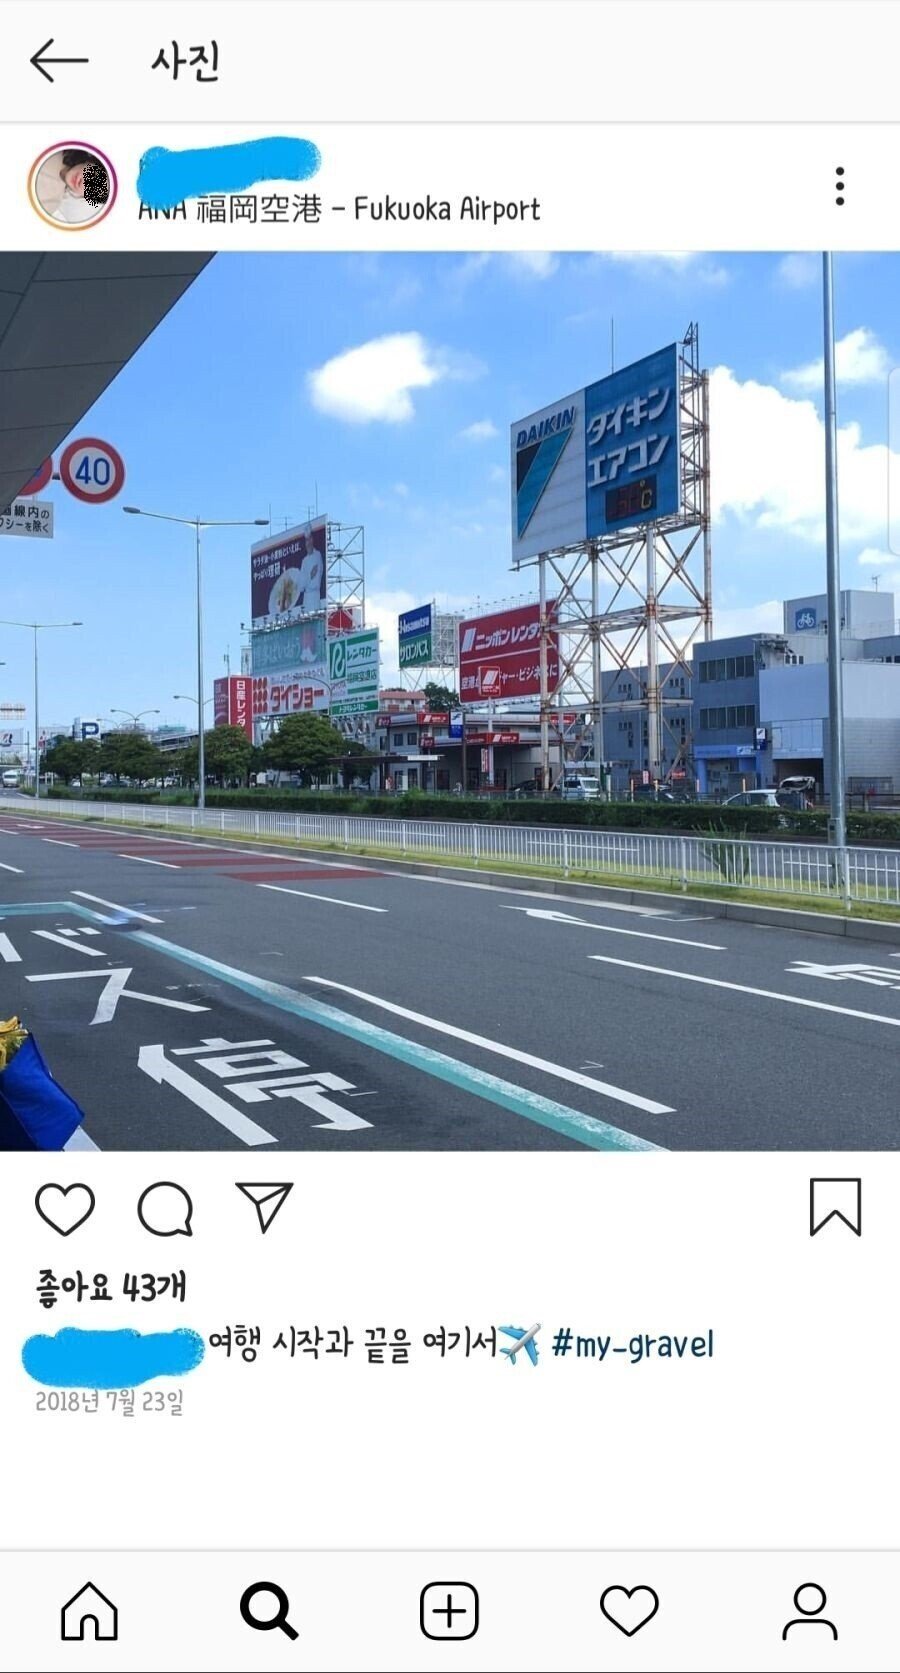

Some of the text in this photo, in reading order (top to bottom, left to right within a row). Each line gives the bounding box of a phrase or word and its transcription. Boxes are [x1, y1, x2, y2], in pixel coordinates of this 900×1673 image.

[516, 405, 577, 446] DAIKIN
[587, 386, 671, 445] ダイキン
[75, 455, 111, 486] 40
[587, 435, 670, 488] エアコン
[475, 622, 543, 651] ニッポンレンタ
[347, 645, 377, 661] レンタカー
[270, 684, 325, 712] ダイショー
[81, 722, 99, 741] P
